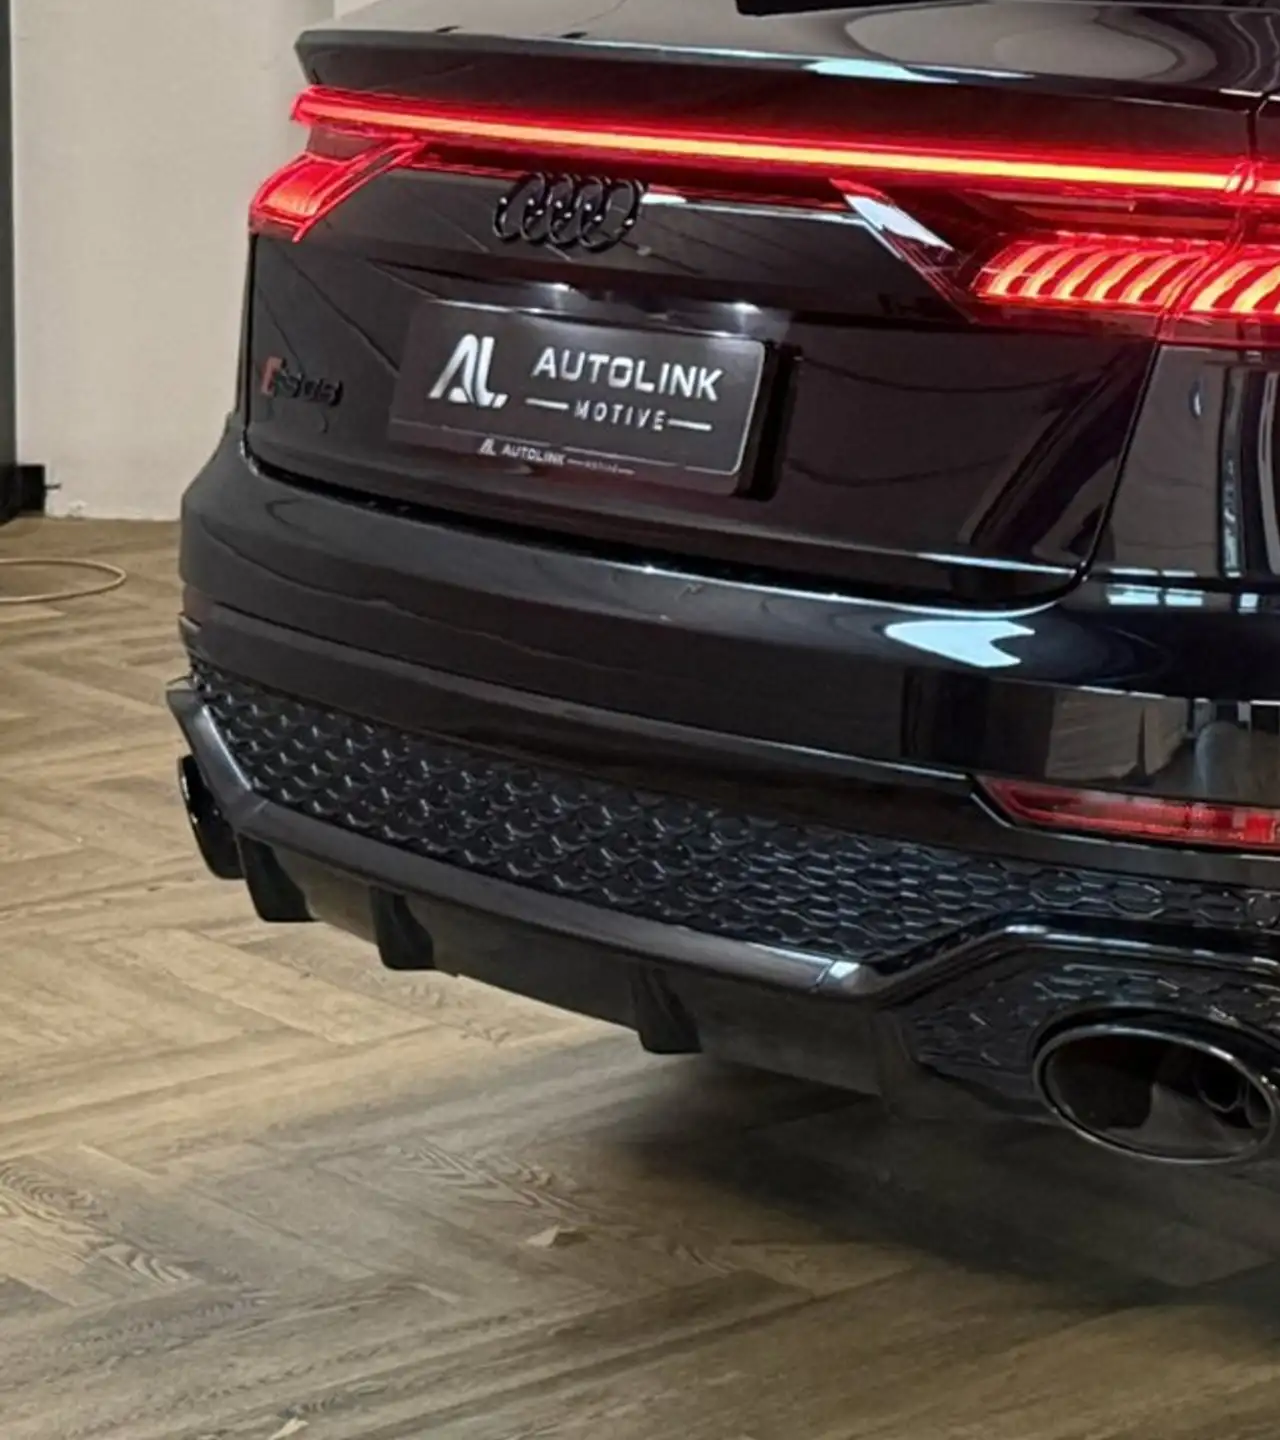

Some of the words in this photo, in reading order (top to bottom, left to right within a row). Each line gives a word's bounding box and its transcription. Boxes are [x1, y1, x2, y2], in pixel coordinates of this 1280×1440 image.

[530, 346, 724, 402] AUTOLINK
[573, 398, 668, 431] MOTIVE
[501, 443, 567, 468] AUTOLINK
